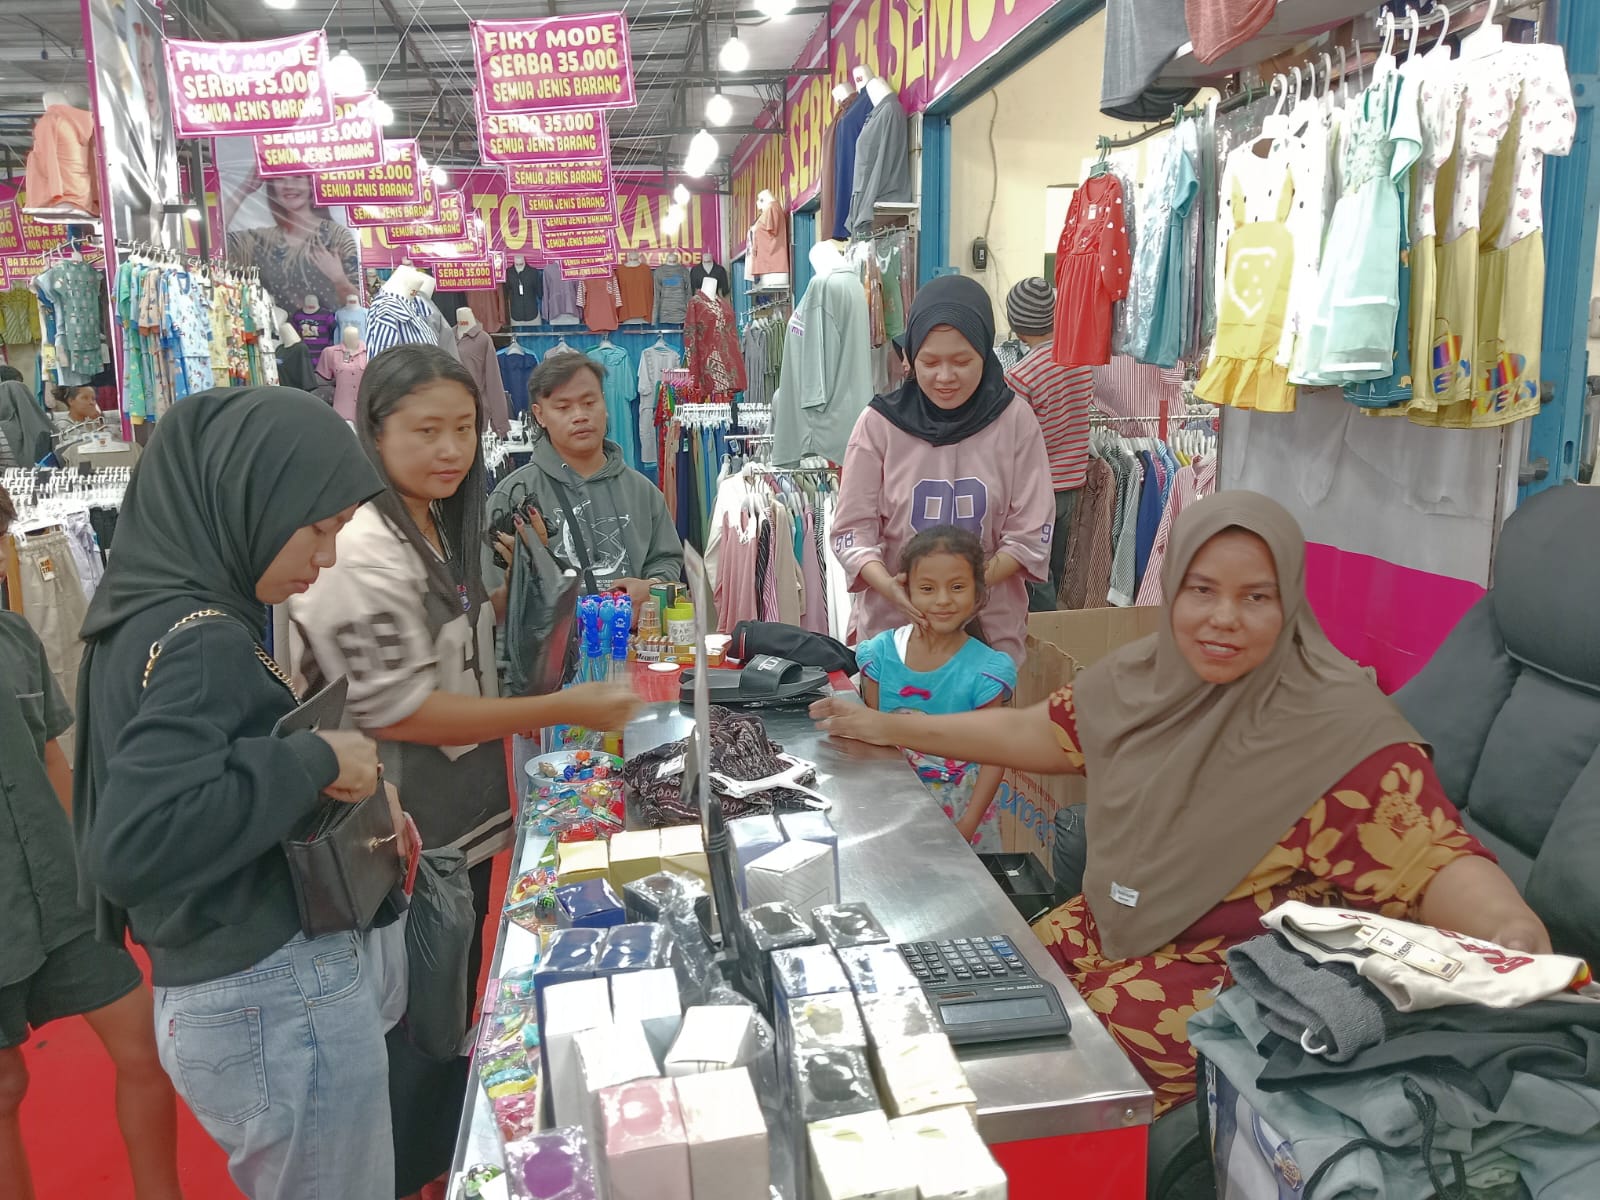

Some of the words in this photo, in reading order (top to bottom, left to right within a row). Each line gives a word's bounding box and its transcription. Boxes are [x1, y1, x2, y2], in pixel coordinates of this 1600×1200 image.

[484, 31, 538, 52] FIKY
[546, 24, 617, 48] MODE
[243, 45, 319, 71] MODE
[488, 52, 553, 78] SERBA
[557, 48, 618, 73] 35.000
[183, 74, 250, 100] SERBA
[254, 70, 320, 96] 35.000
[493, 81, 535, 102] SEMUA
[537, 78, 571, 99] JENIS
[574, 75, 621, 97] BARANG
[186, 103, 231, 124] SEMUA
[234, 100, 271, 121] JENIS
[273, 96, 324, 119] BARANG
[488, 115, 541, 135] SERBA
[544, 113, 594, 132] 35.000
[490, 137, 524, 154] SEMUA
[526, 136, 554, 152] JENIS
[557, 134, 596, 151] BARANG
[264, 149, 301, 166] SEMUA
[302, 146, 333, 163] JENIS
[334, 142, 375, 160] BARANG
[368, 164, 412, 180] 35.000
[515, 172, 544, 186] SEMUA
[545, 170, 569, 185] JENIS
[570, 169, 604, 184] BARANG
[321, 184, 352, 198] SEMUA
[353, 184, 378, 197] JENIS
[379, 183, 414, 197] BARANG
[381, 206, 403, 219] JENIS
[404, 203, 434, 217] BARANG
[529, 198, 554, 211] SEMUA
[555, 197, 575, 210] JENIS
[576, 196, 606, 209] BARANG
[22, 225, 50, 238] ERBA
[546, 238, 566, 249] SEMUA
[567, 237, 583, 247] JENIS
[438, 268, 465, 278] SERBA
[466, 267, 490, 277] 35.000
[439, 279, 457, 287] SEMUA
[457, 278, 471, 286] JENIS
